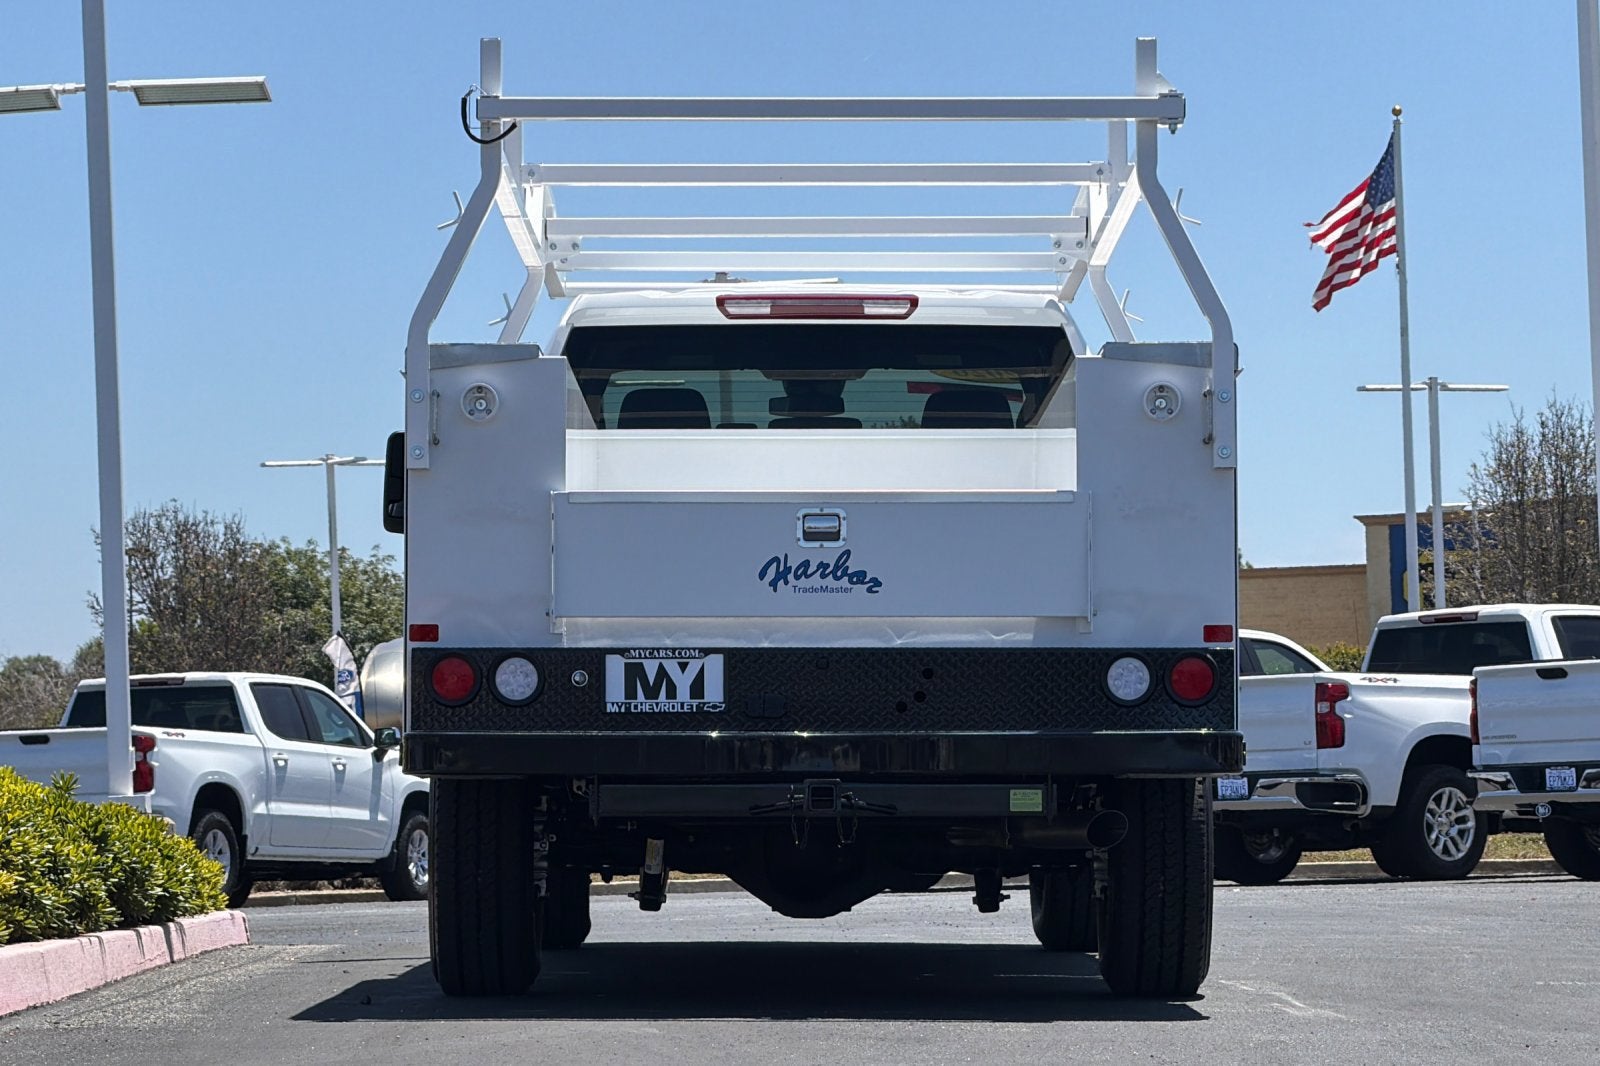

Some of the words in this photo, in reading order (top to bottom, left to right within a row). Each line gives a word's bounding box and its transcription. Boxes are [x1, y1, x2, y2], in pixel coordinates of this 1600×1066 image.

[758, 548, 883, 594] Harbor
[791, 585, 854, 594] TradeMaster
[629, 649, 700, 658] MYCARS.COM
[606, 702, 626, 713] MY
[630, 702, 699, 713] CHEVROLET
